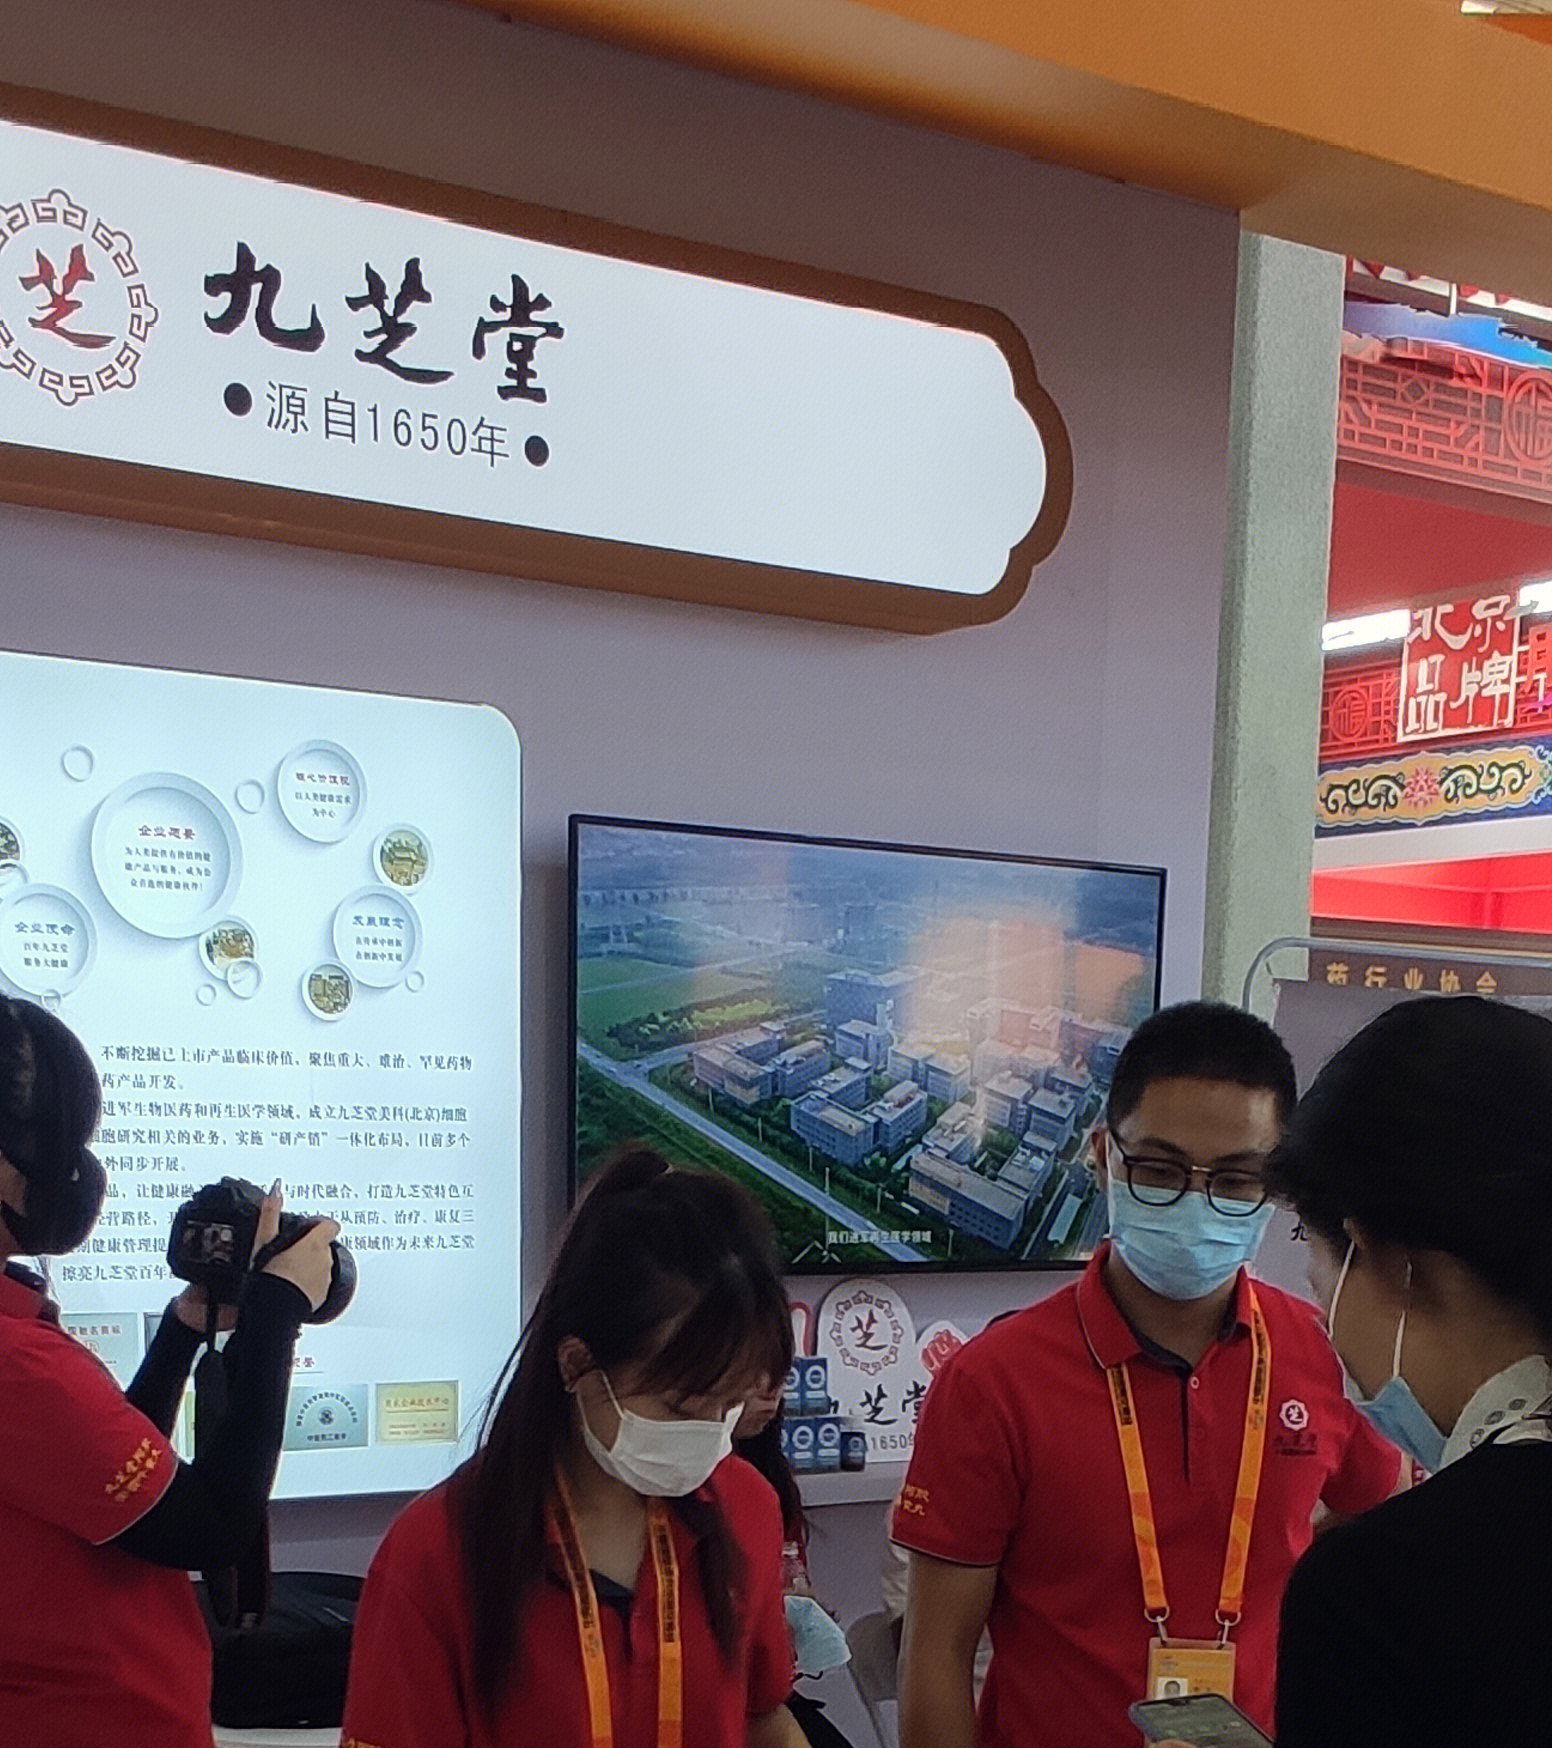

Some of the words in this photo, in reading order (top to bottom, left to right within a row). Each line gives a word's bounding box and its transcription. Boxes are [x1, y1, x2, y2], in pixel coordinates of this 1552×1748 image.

[19, 243, 117, 349] 芝
[203, 241, 565, 404] 九芝堂
[265, 379, 511, 468] 源自1650年
[1407, 595, 1512, 654] 北京
[1404, 650, 1516, 734] 品牌
[99, 1156, 187, 1172] 外同步开展。
[849, 1309, 889, 1351] 芝
[831, 1380, 926, 1426] 芝堂
